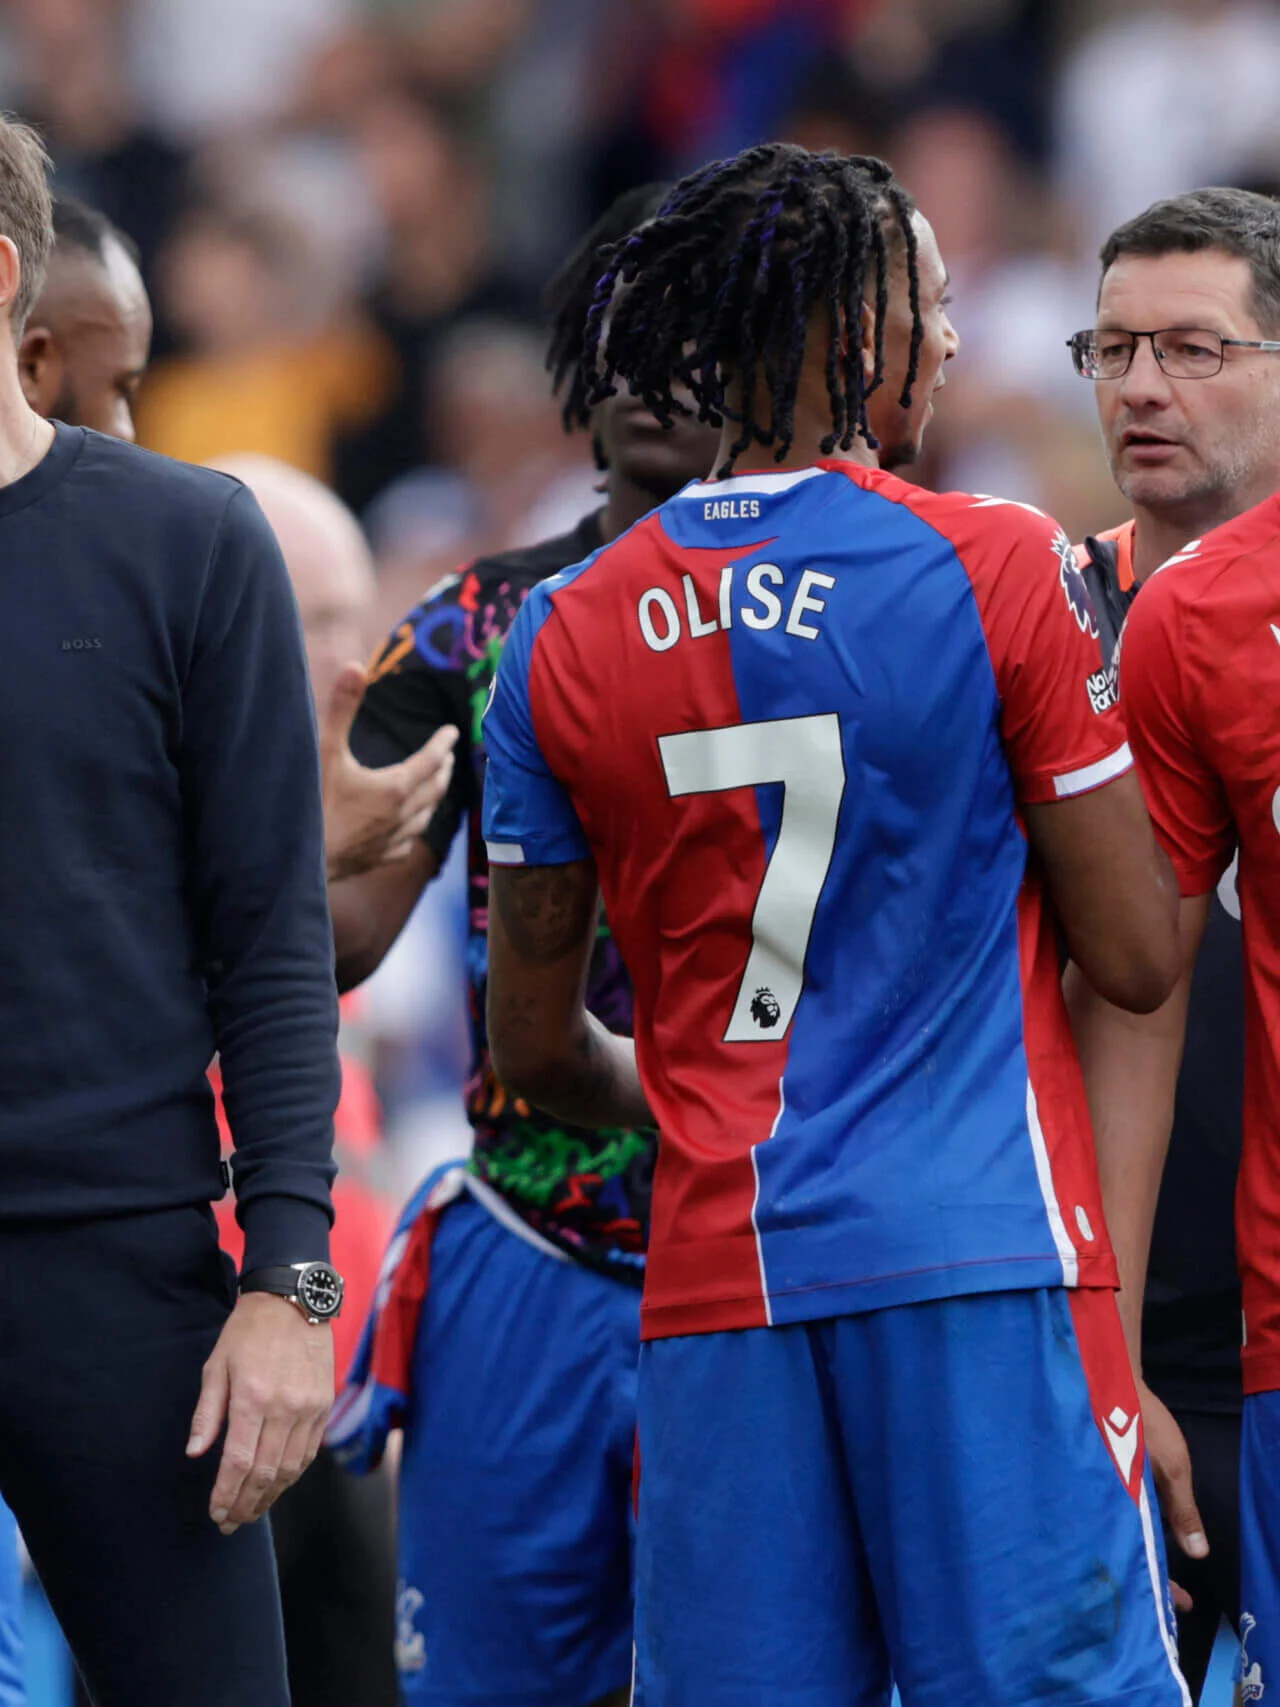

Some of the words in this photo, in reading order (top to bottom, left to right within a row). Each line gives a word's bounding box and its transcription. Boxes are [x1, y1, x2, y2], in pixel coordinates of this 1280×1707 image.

[704, 499, 761, 521] EAGLES
[637, 563, 836, 652] OLISE
[61, 637, 102, 650] BOSS
[657, 712, 847, 1042] 7
